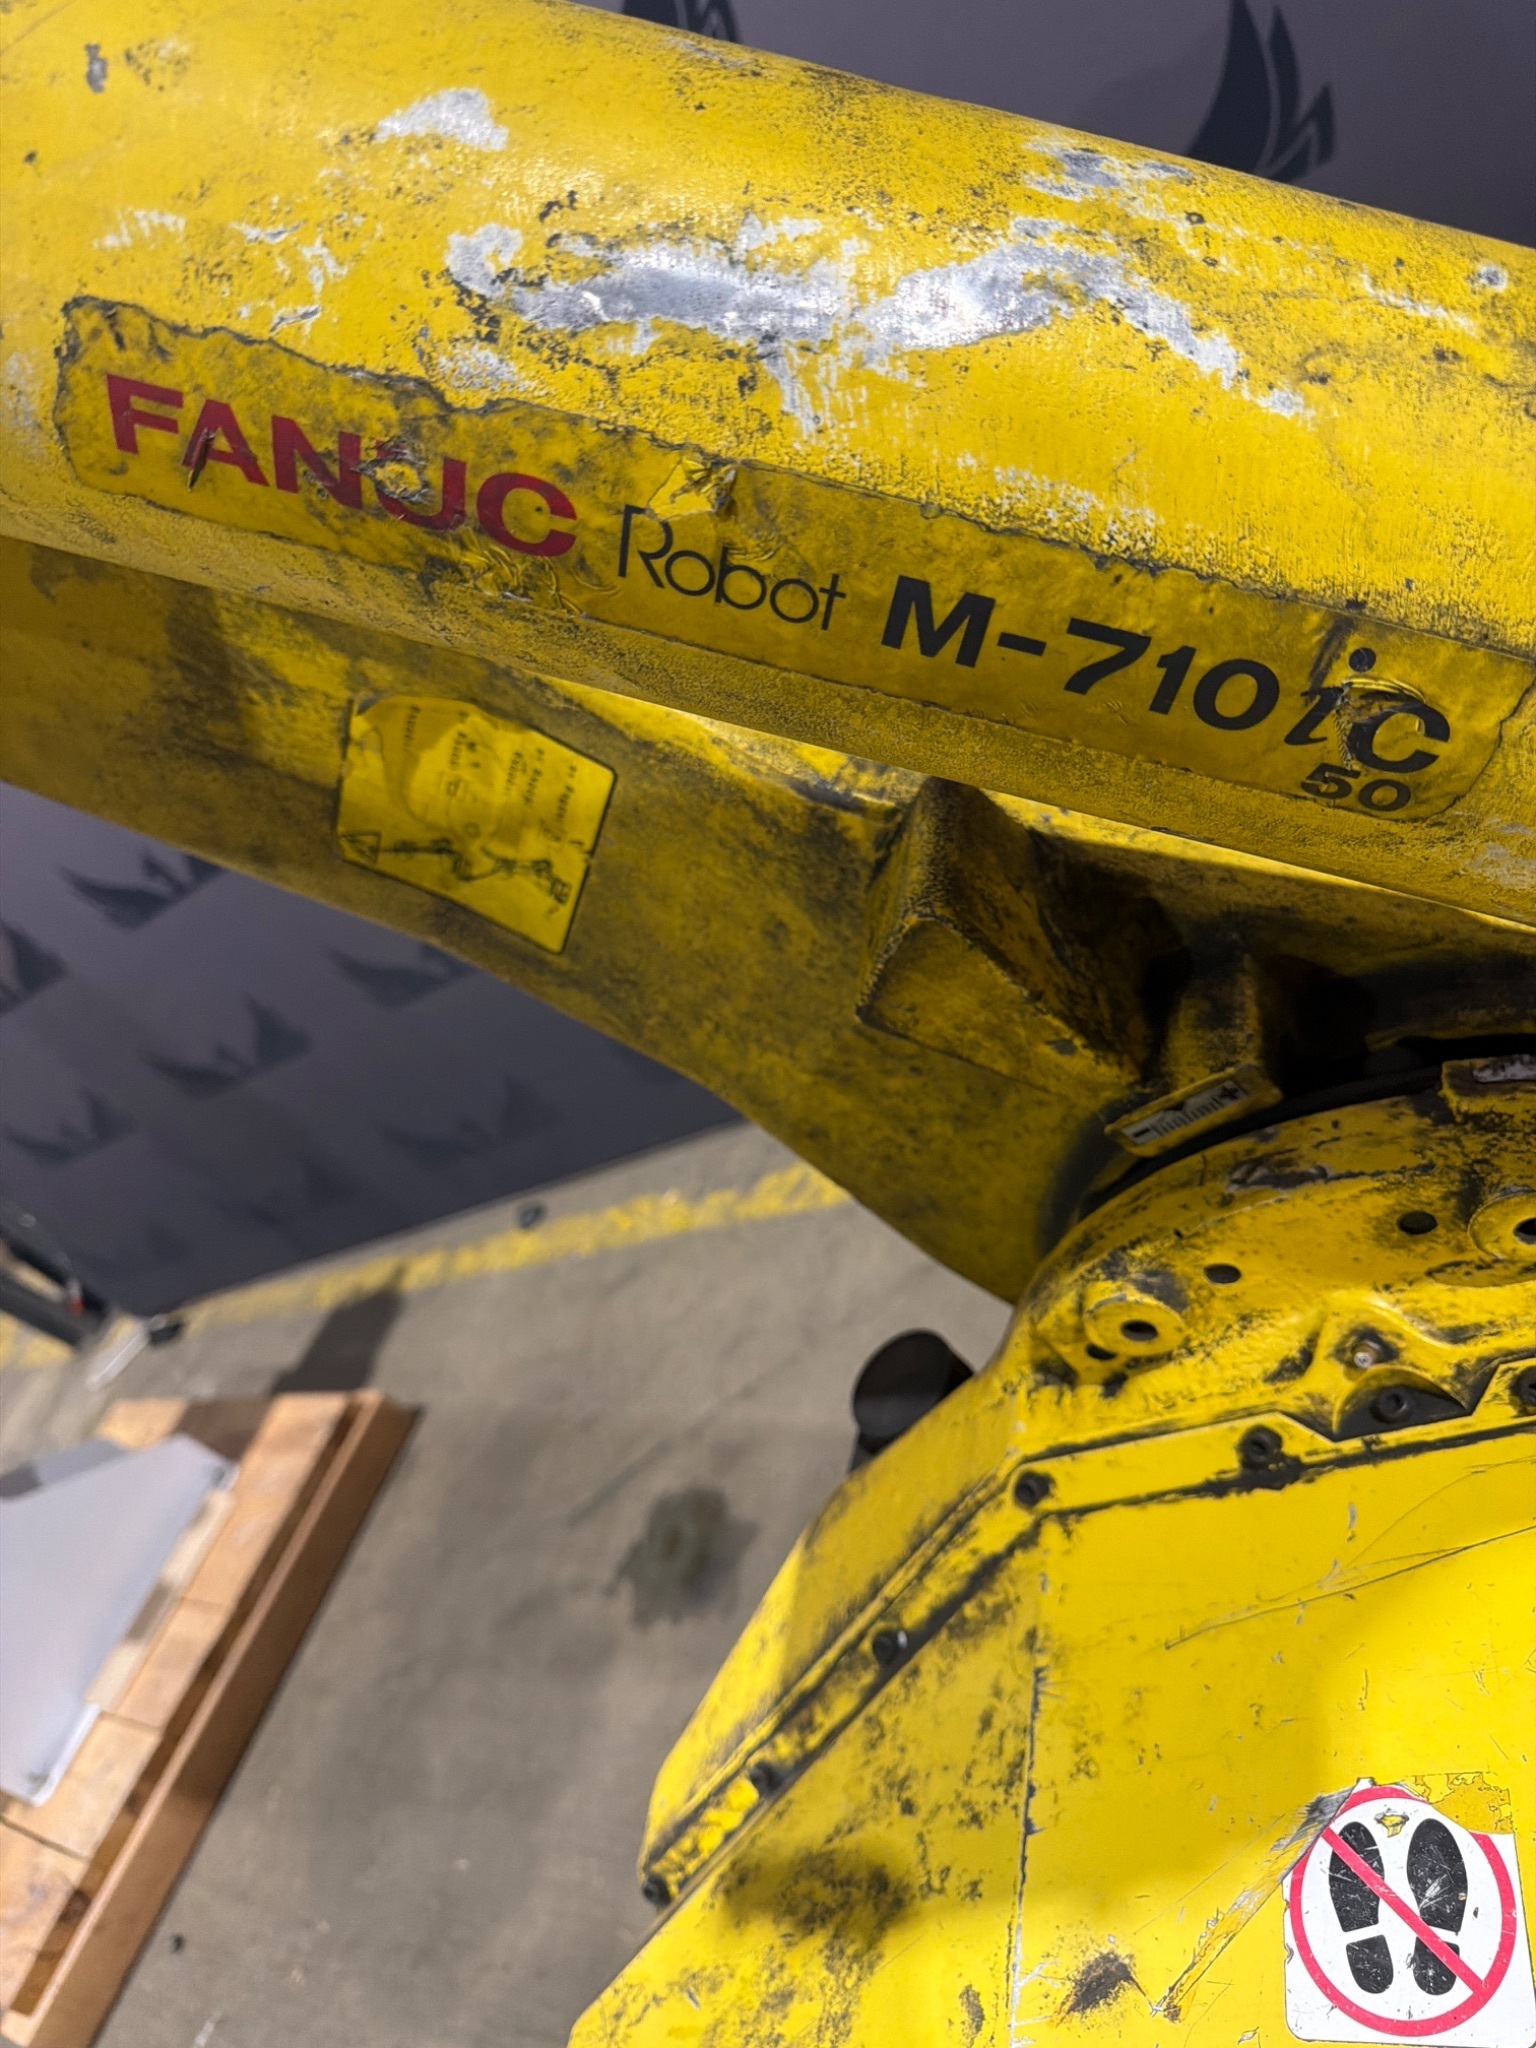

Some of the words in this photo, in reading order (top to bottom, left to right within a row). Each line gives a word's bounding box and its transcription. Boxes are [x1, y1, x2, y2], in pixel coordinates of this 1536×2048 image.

[107, 373, 577, 557] FANUC
[617, 503, 846, 631] Robot
[1301, 763, 1411, 812] 50
